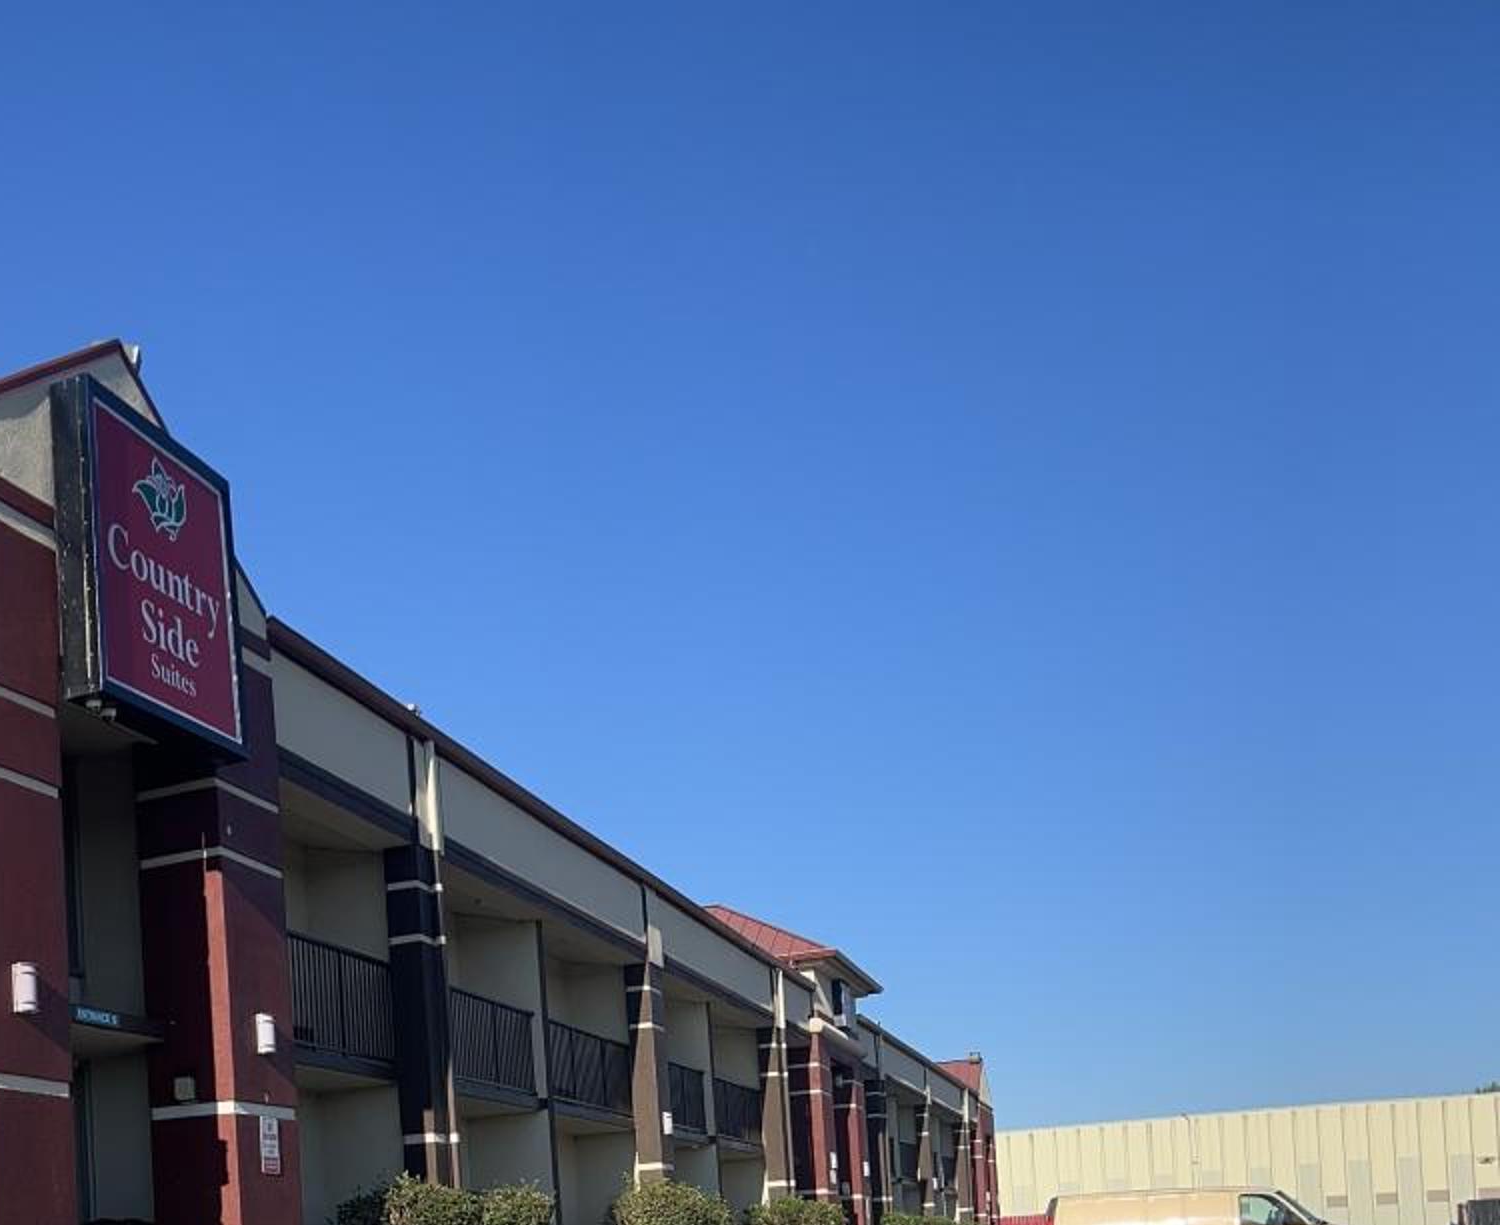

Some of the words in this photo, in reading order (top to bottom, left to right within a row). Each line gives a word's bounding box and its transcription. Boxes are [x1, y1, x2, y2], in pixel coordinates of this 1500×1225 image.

[108, 524, 220, 639] Country
[141, 599, 199, 668] Side
[151, 653, 197, 697] Suites
